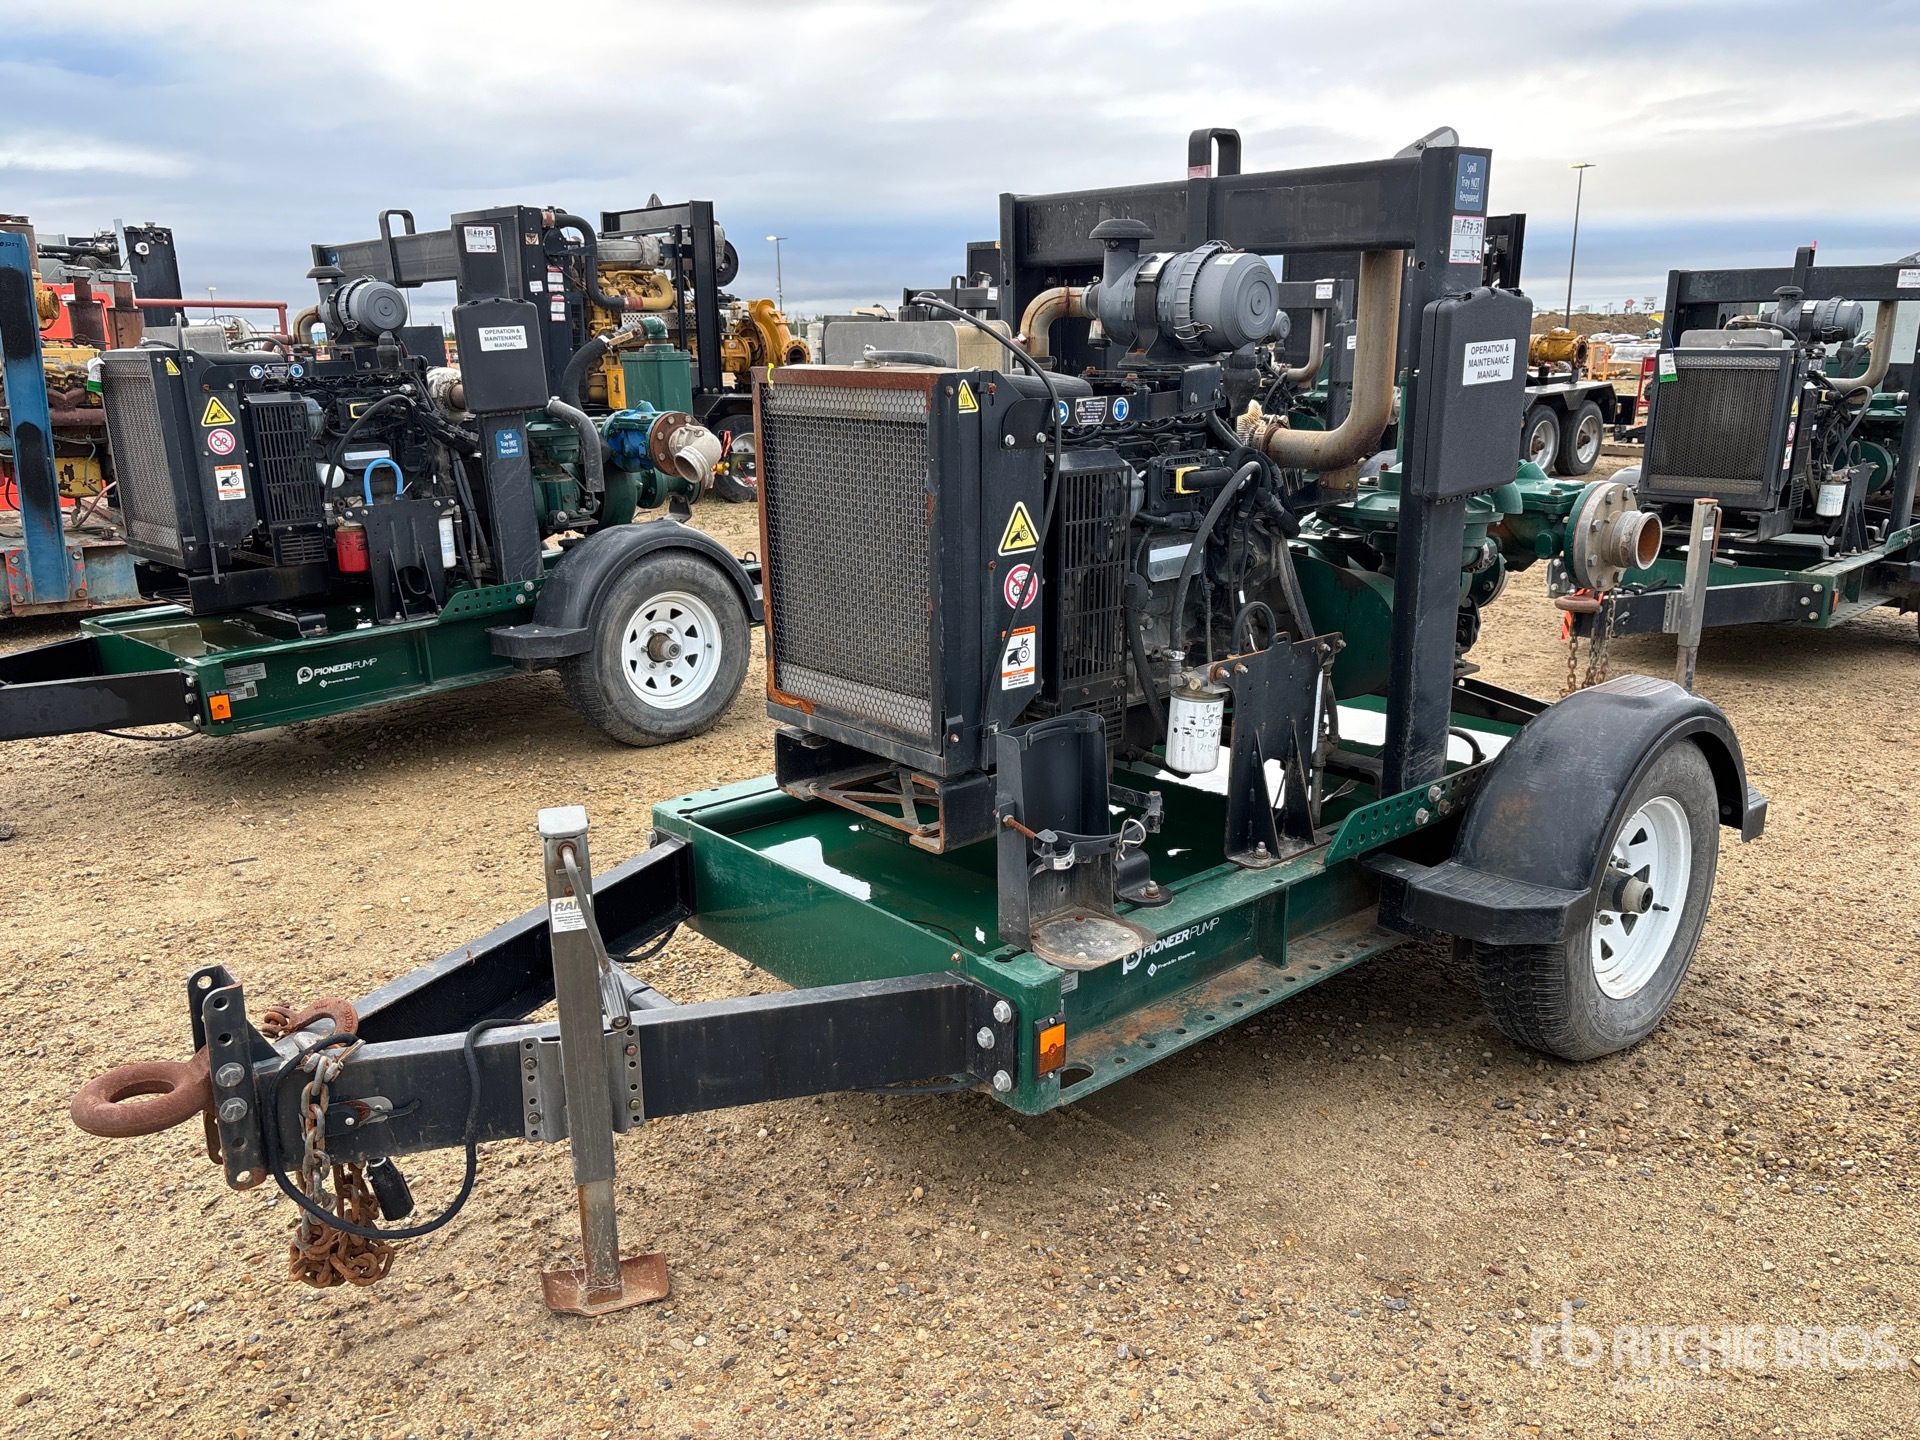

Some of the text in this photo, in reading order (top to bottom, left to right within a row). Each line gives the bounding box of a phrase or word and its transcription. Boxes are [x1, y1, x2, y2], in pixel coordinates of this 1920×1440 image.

[1467, 162, 1477, 174] Spill
[1462, 176, 1480, 189] Tray NOT
[1460, 191, 1479, 204] Required
[1470, 344, 1509, 355] OPERATION &
[1468, 356, 1510, 368] MAINTENANCE
[1477, 369, 1501, 380] MANUAL
[1157, 950, 1196, 970] Franklin Electric
